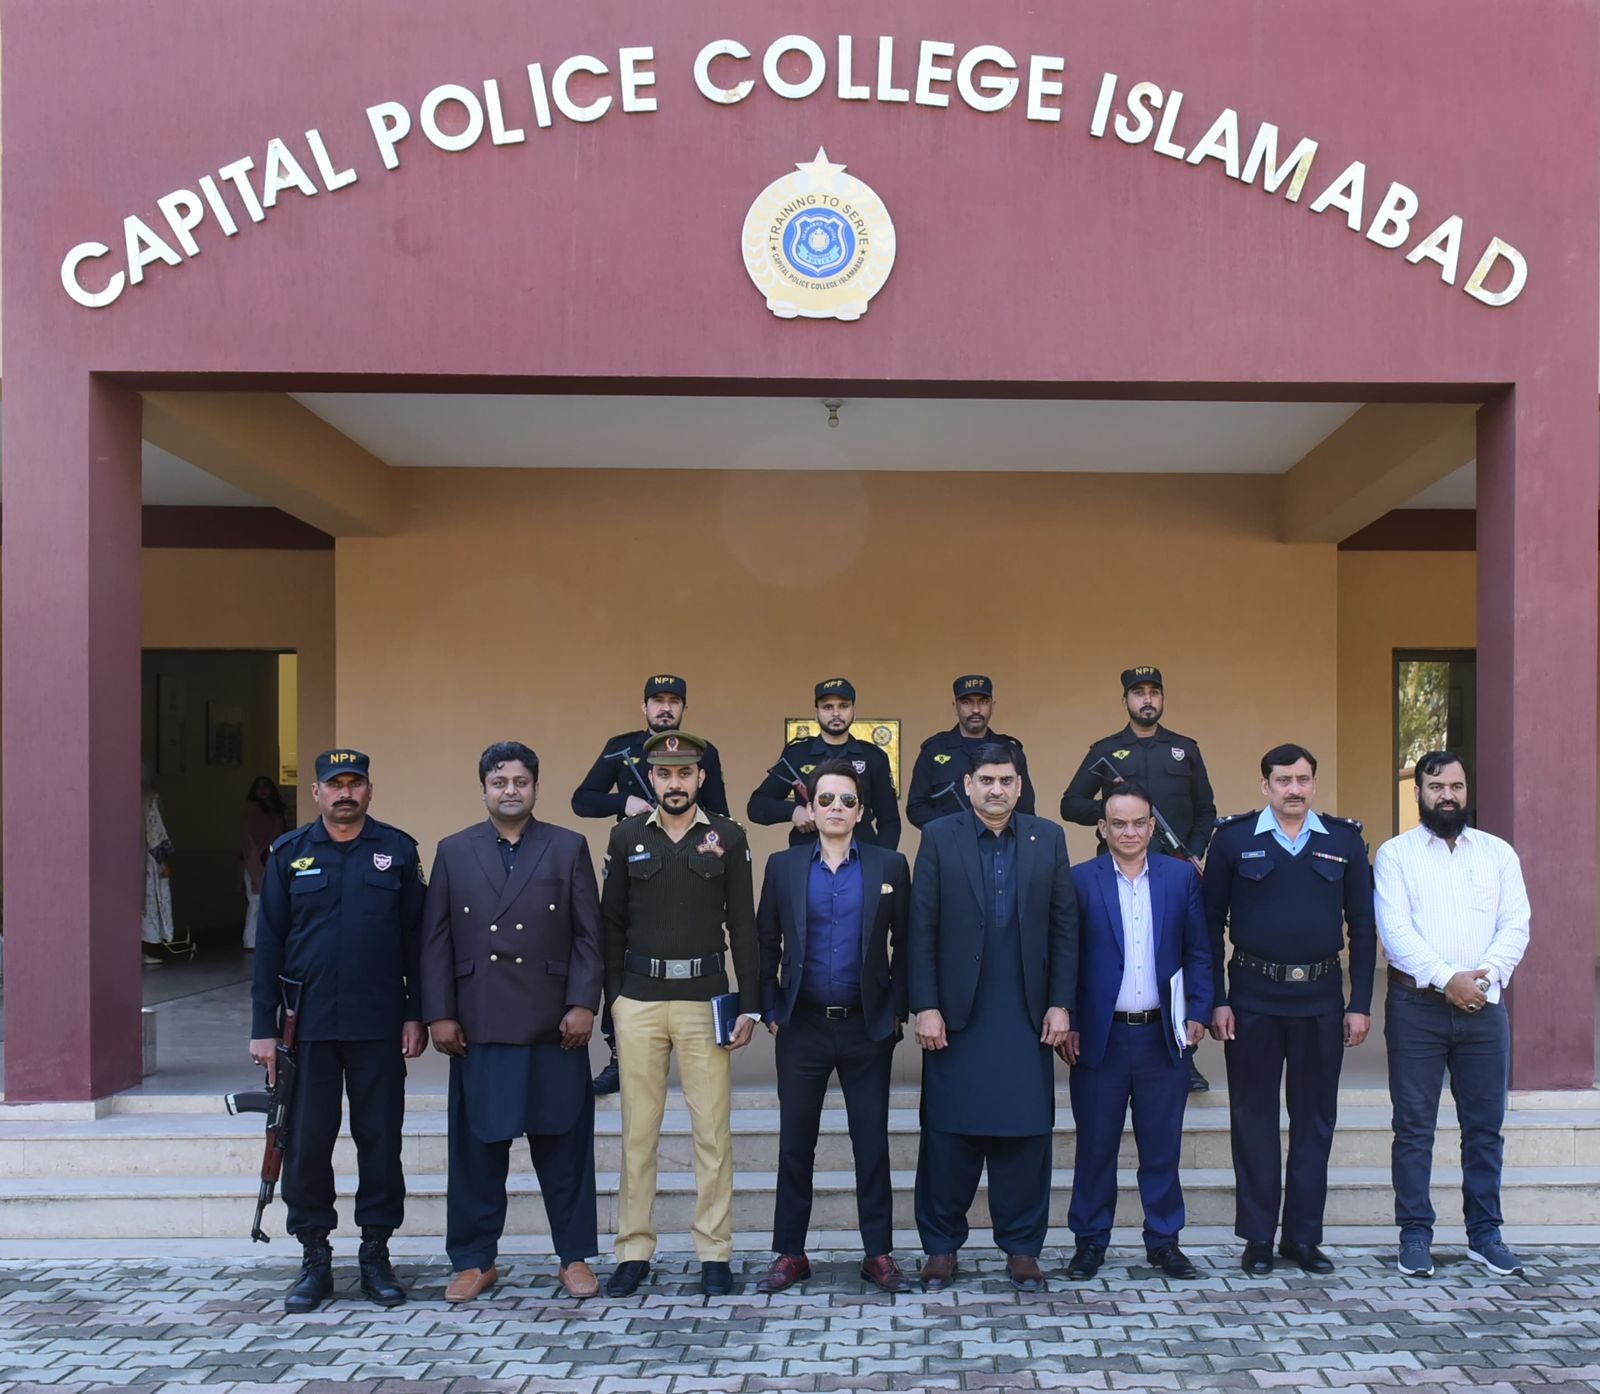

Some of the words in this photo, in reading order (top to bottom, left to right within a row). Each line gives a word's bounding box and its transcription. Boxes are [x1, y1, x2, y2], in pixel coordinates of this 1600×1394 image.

[61, 129, 357, 308] CAPITAL
[365, 46, 658, 170] POLICE
[693, 34, 1064, 121] COLLEGE
[1090, 72, 1528, 307] ISLAMABAD
[769, 194, 817, 242] TRAINING
[822, 194, 840, 207] TO
[841, 205, 869, 246] SERVE
[772, 253, 788, 277] CAPITAL
[788, 273, 810, 289] POLICE
[810, 280, 839, 290] COLLEGE
[838, 256, 865, 286] ISLAMABAD
[1135, 667, 1156, 676] NPF
[654, 676, 675, 685] NPF
[823, 680, 844, 689] NPF
[964, 679, 985, 688] NPF
[330, 753, 357, 764] NPF
